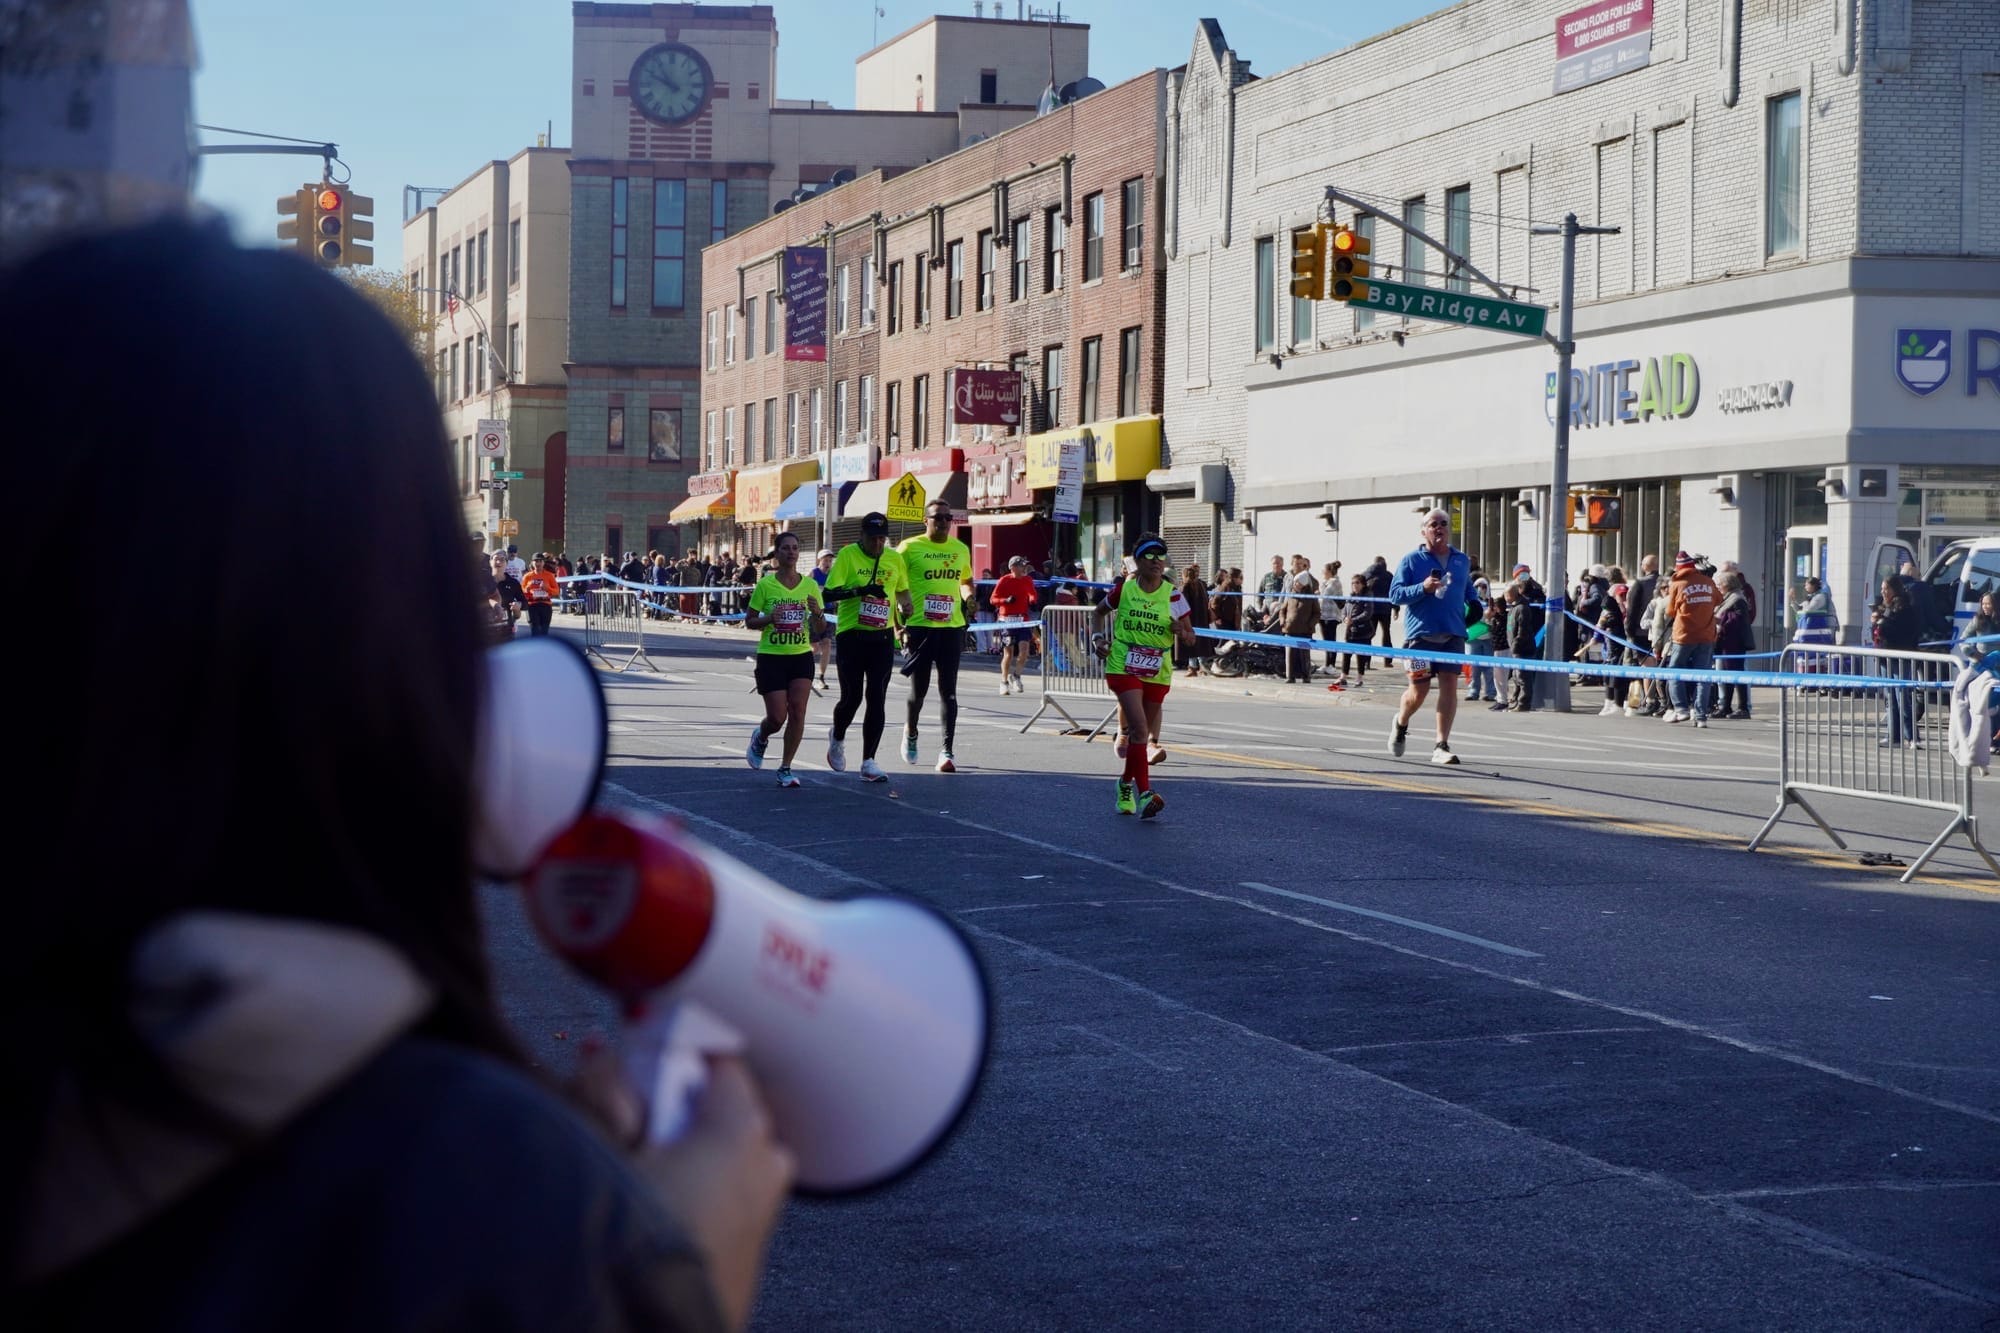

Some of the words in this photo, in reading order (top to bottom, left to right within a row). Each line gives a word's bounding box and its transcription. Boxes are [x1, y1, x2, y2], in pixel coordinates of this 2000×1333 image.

[1563, 18, 1588, 37] SECOND
[1589, 10, 1609, 27] FLOOR
[1610, 6, 1623, 20] FOR
[1624, 0, 1643, 15] LEASE
[1590, 23, 1615, 42] SQUARE
[1615, 17, 1632, 33] FEET
[791, 266, 814, 280] Queens
[791, 281, 807, 292] Bronx
[792, 285, 823, 301] Manhattan
[1368, 286, 1413, 312] Bay
[1421, 296, 1489, 323] Ridge
[1496, 308, 1527, 328] Av
[797, 310, 823, 324] Brooklyn
[792, 325, 815, 338] Queens
[1637, 352, 1700, 422] AID
[1717, 380, 1794, 415] PHARMACY
[748, 486, 760, 513] 99
[889, 507, 921, 518] SCHOOL
[924, 569, 961, 580] GUIDE
[1684, 584, 1712, 596] TEXAS
[863, 603, 888, 616] 14298
[927, 601, 952, 611] 14601
[781, 611, 804, 620] 4625
[1129, 609, 1159, 621] GUIDE
[1123, 620, 1165, 635] GLADYS
[1130, 653, 1159, 667] 13722
